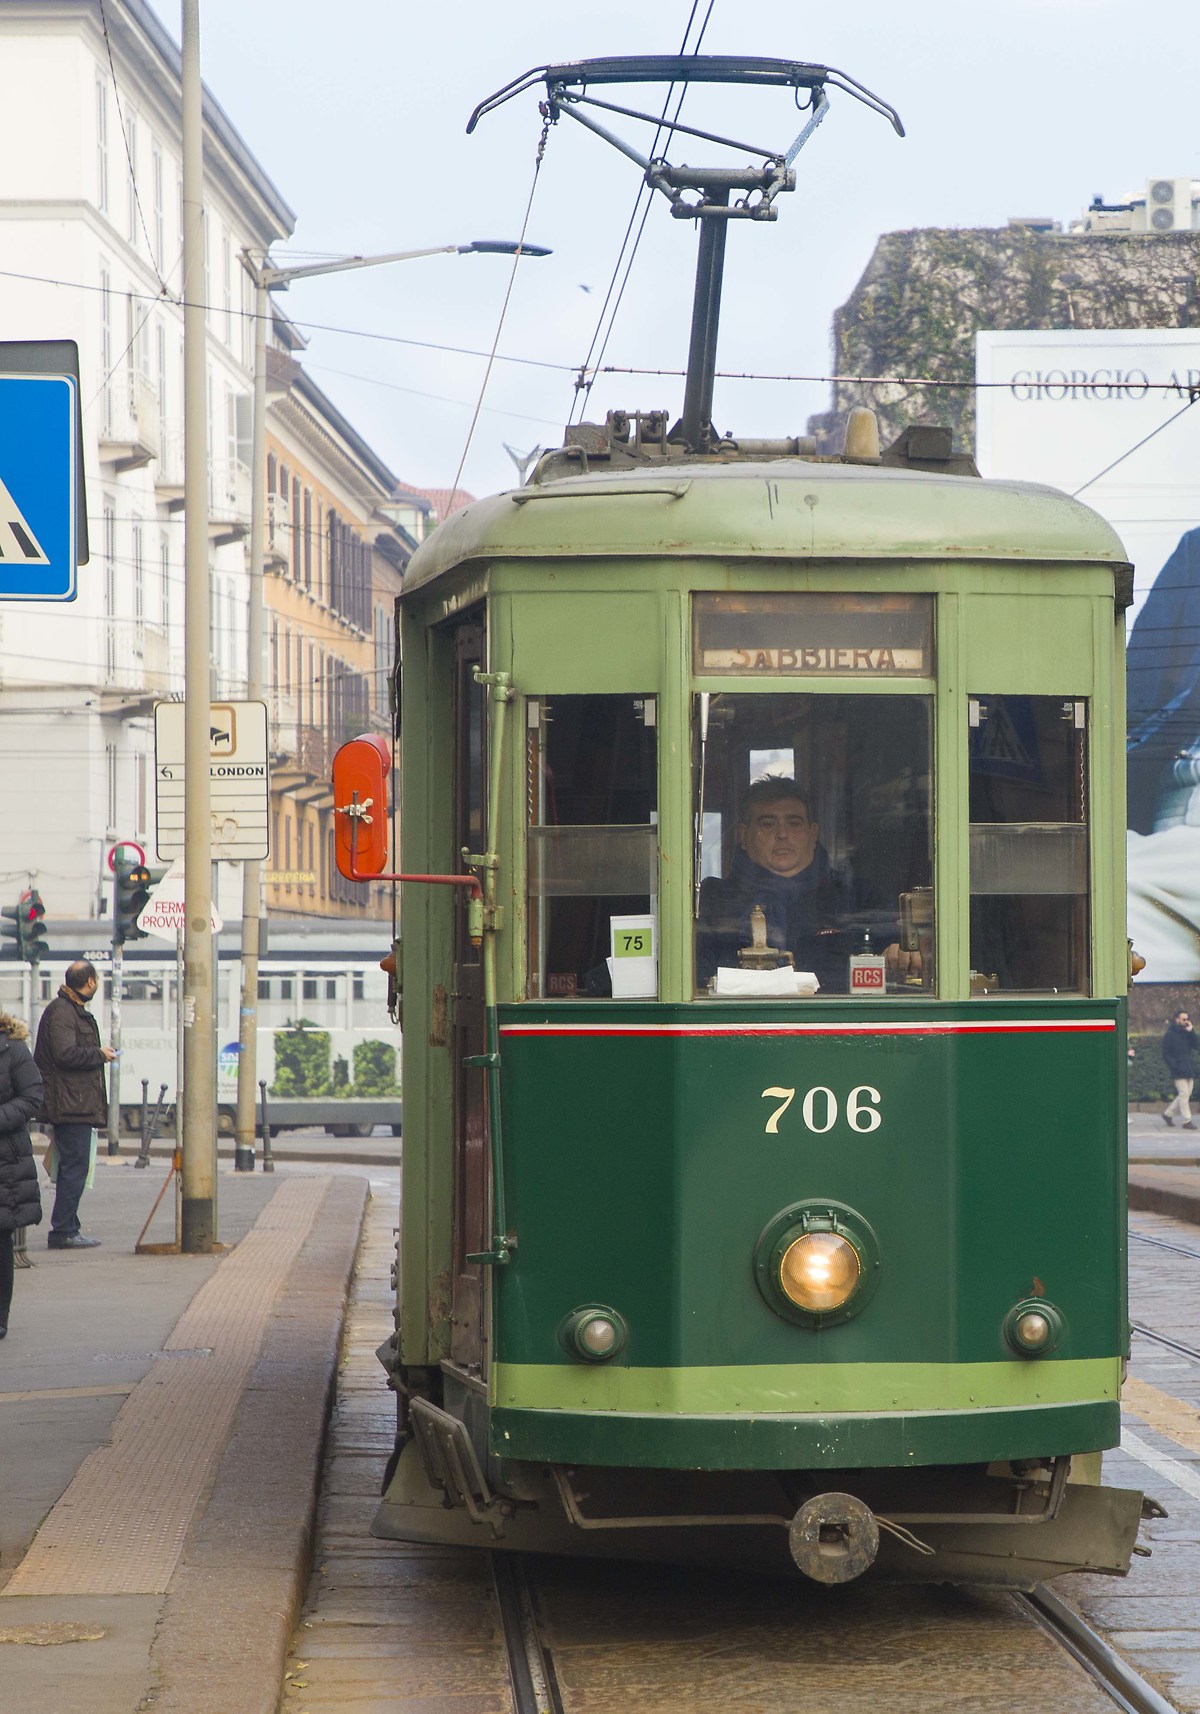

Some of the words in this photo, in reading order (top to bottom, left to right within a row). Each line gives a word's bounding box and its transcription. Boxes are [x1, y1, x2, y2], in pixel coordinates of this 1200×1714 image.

[1010, 368, 1149, 401] GIORGIO
[731, 648, 897, 669] SABBIERA
[210, 767, 264, 776] LONDON
[155, 901, 185, 914] FERM
[623, 935, 643, 951] 75
[83, 951, 109, 960] 4604
[550, 976, 575, 991] RCS
[854, 969, 881, 985] RCS
[761, 1085, 882, 1134] 706
